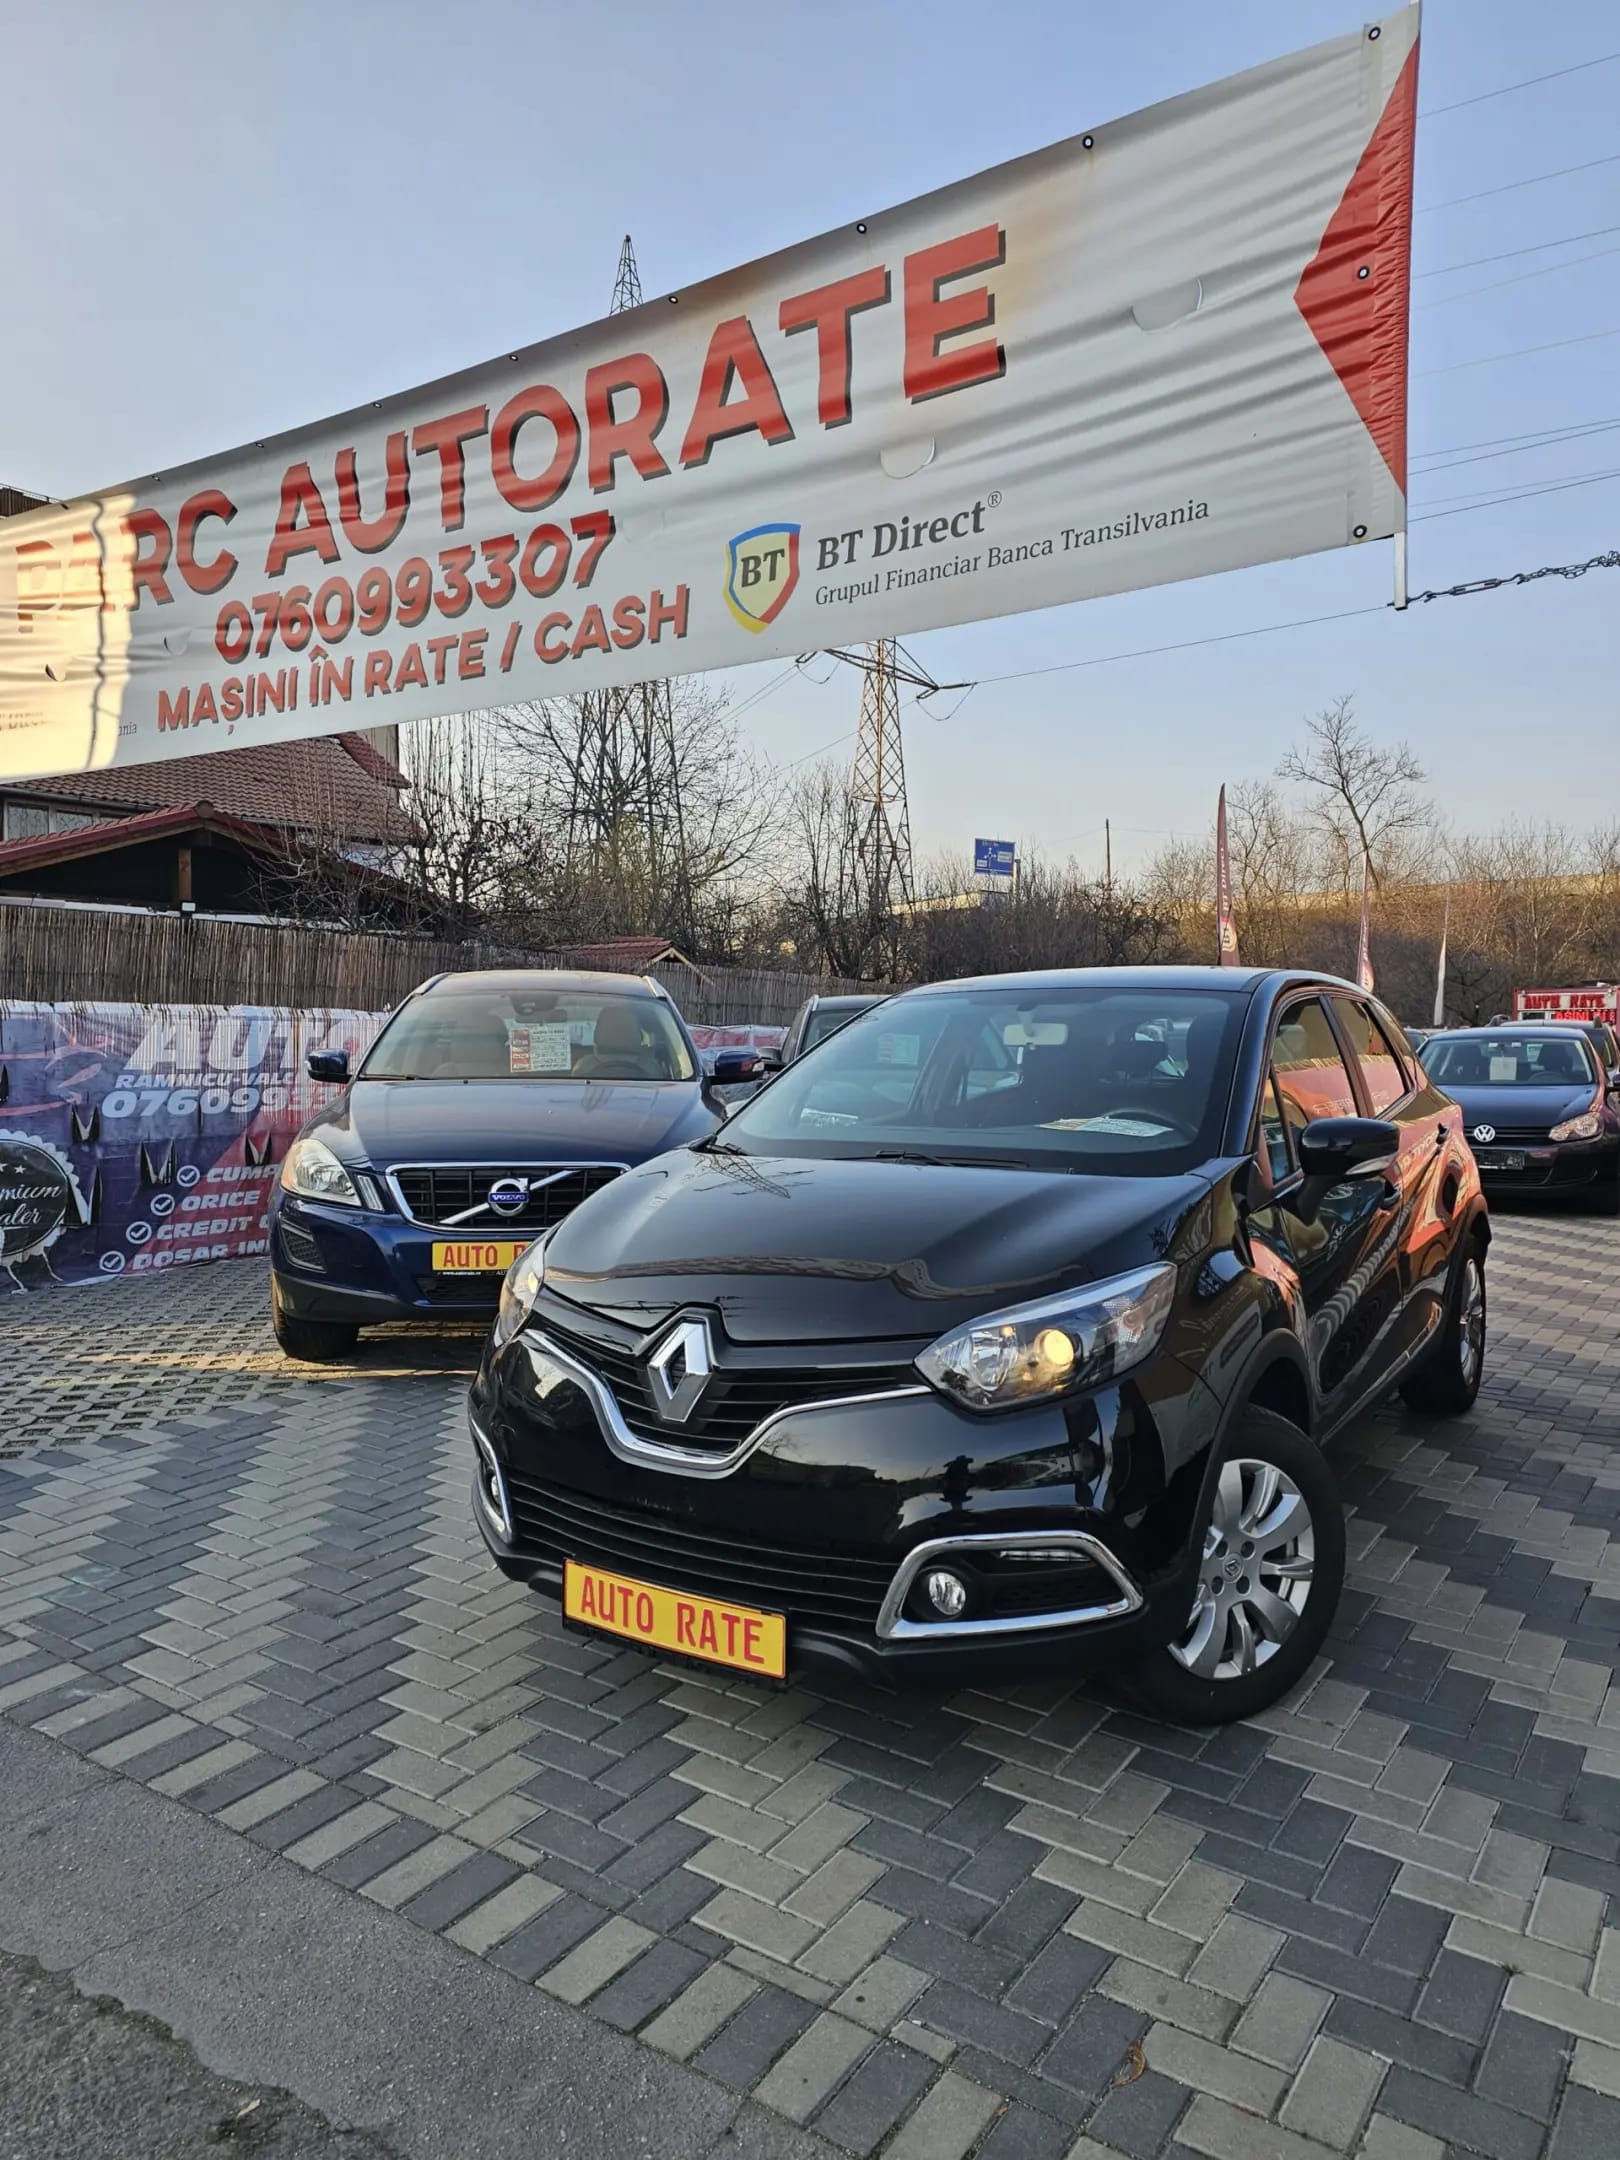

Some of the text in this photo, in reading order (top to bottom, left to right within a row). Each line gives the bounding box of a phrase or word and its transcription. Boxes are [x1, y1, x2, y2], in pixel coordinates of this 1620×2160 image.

[264, 223, 1006, 578] AUTORATE
[815, 498, 1210, 605] Grupul Financiar Banca Transilvania
[816, 530, 863, 571] BT
[740, 549, 785, 588] BT
[214, 509, 617, 664] 0760993307
[157, 666, 298, 735] MAȘINI
[308, 645, 353, 707] ÎN
[365, 628, 490, 698] RATE
[533, 584, 690, 664] CASH
[206, 1164, 280, 1183] CUMP
[0, 1184, 62, 1200] mium
[181, 1190, 261, 1211] ORICE
[0, 1203, 41, 1225] aler
[157, 1215, 253, 1241] CREDIT
[132, 1243, 229, 1270] DOSAR
[443, 1245, 498, 1268] AUTO
[581, 1575, 765, 1664] AUTO RATE
